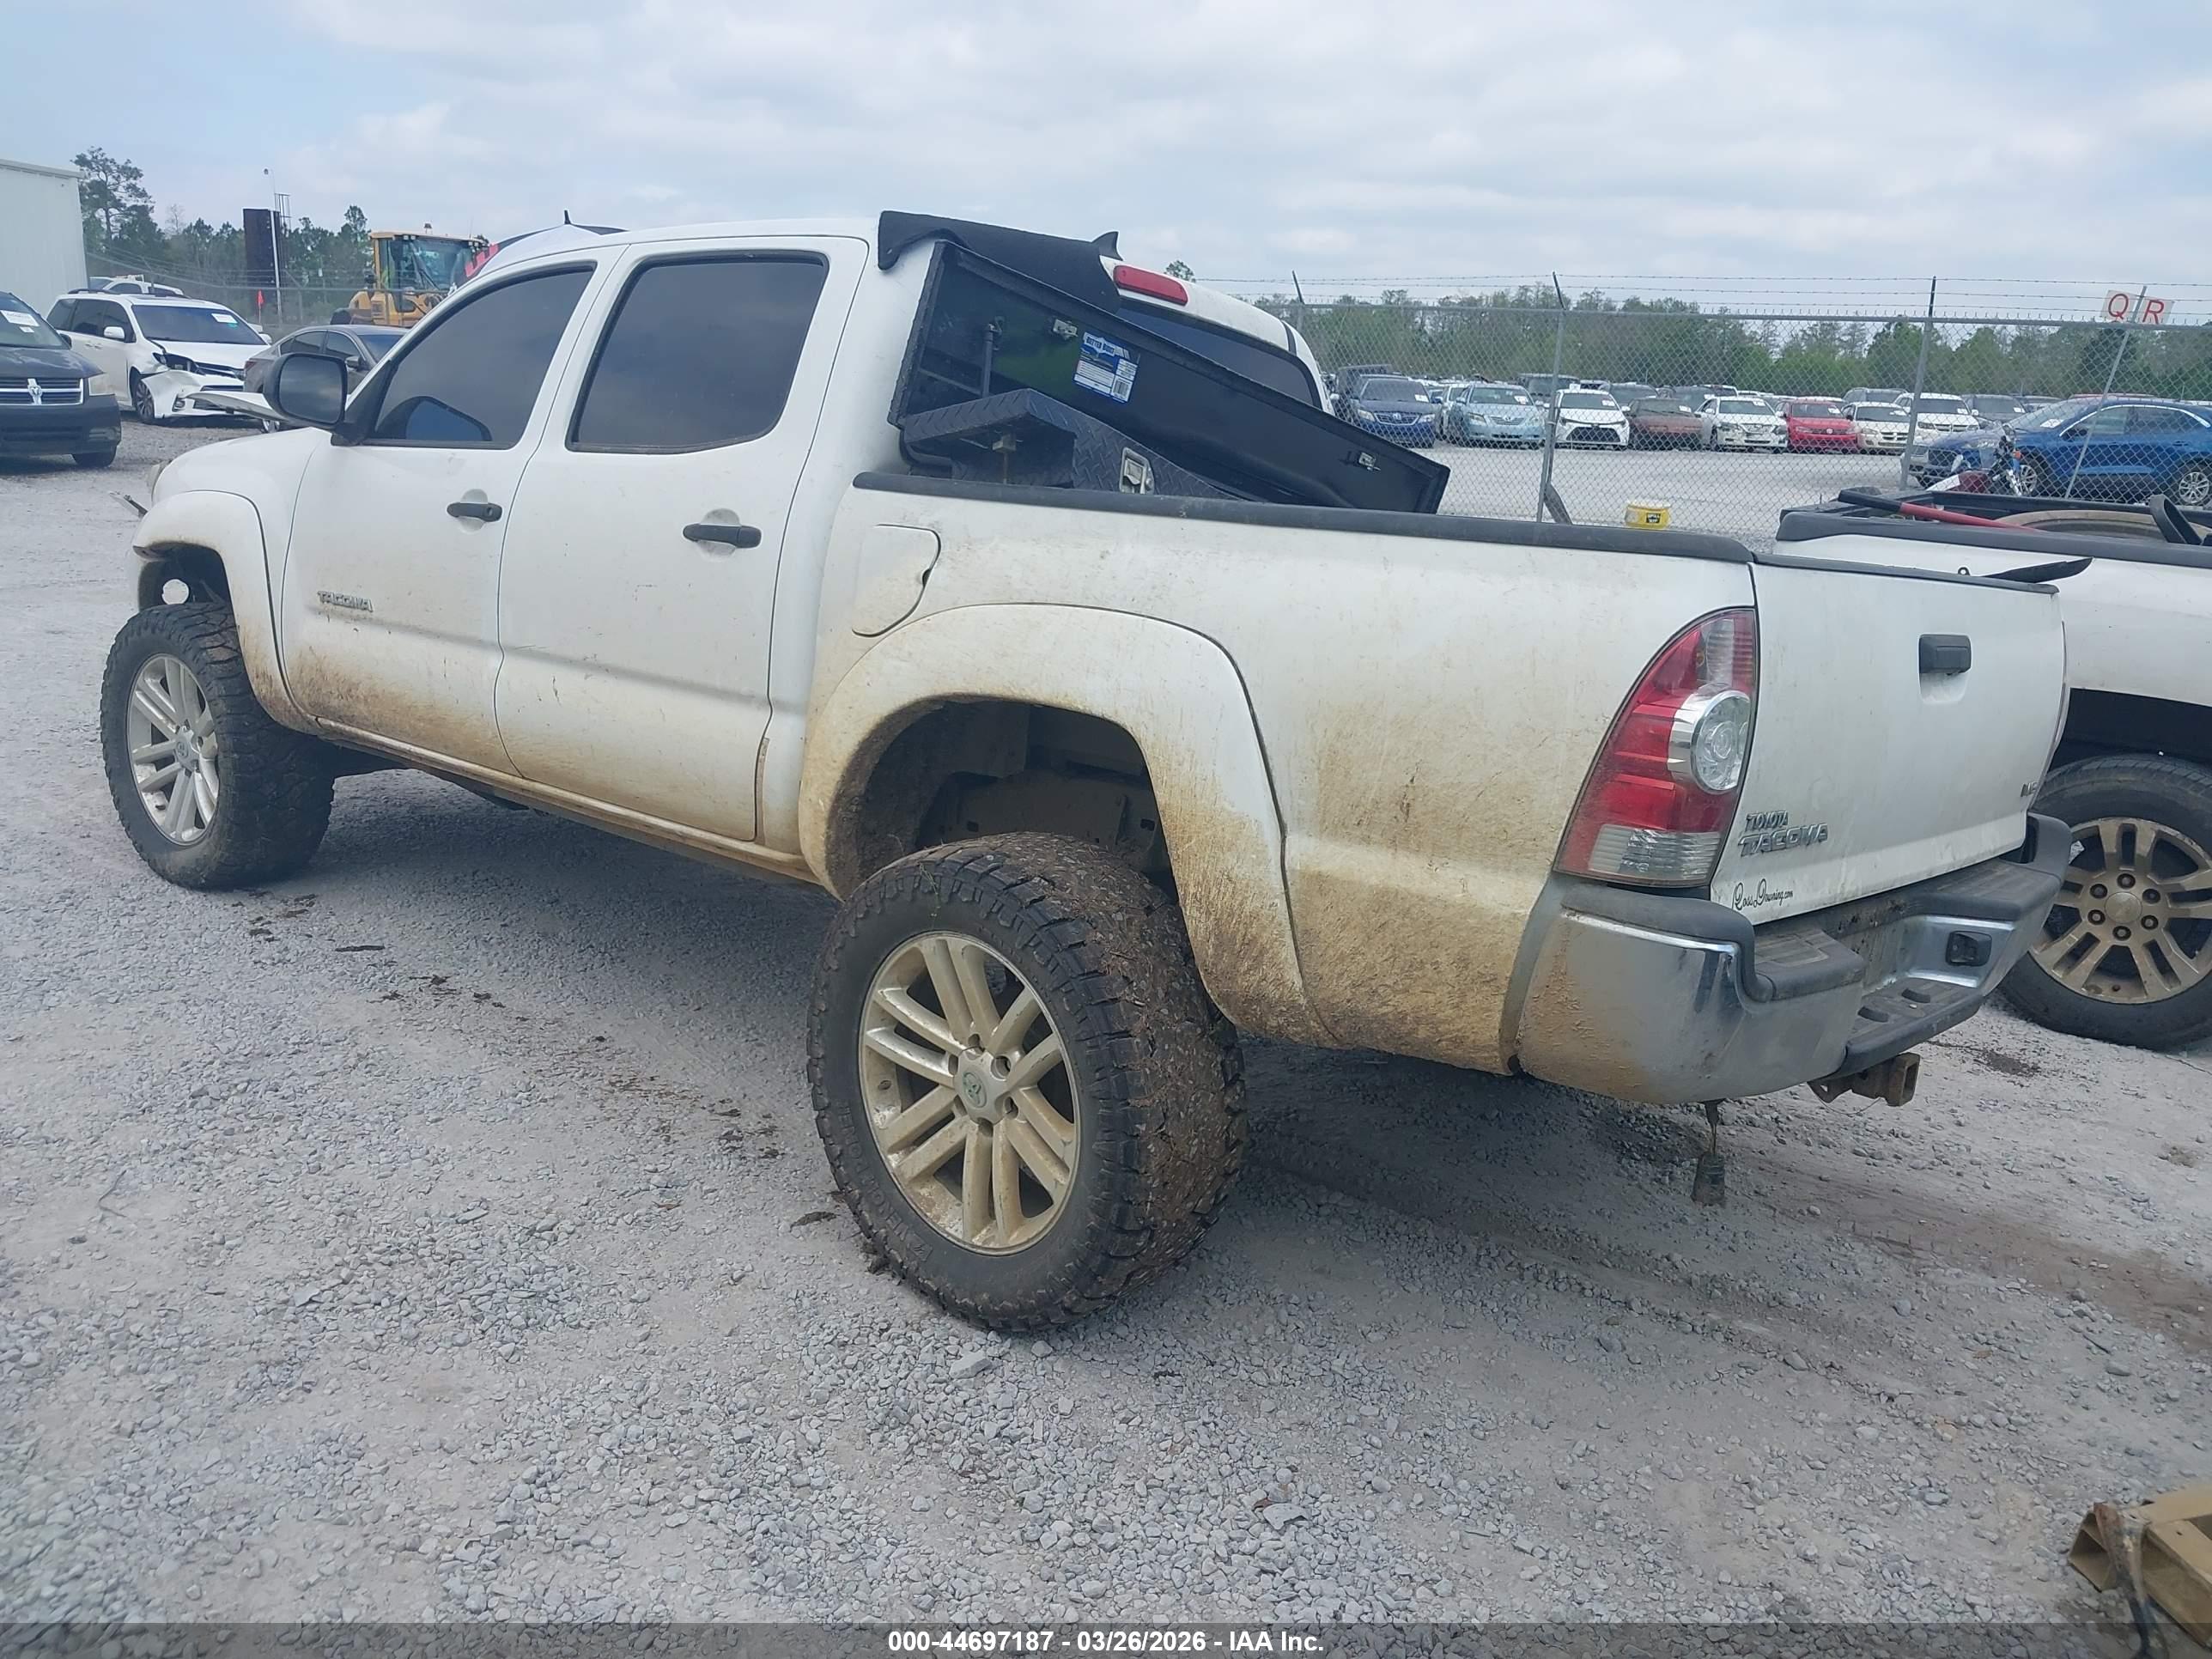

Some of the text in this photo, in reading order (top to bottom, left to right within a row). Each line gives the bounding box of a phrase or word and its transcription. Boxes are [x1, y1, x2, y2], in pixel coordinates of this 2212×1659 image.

[2107, 293, 2165, 325] Q R
[317, 590, 373, 613] TACOMA
[1745, 810, 1789, 832] TOYOTA
[1738, 823, 1828, 857] TACOMA
